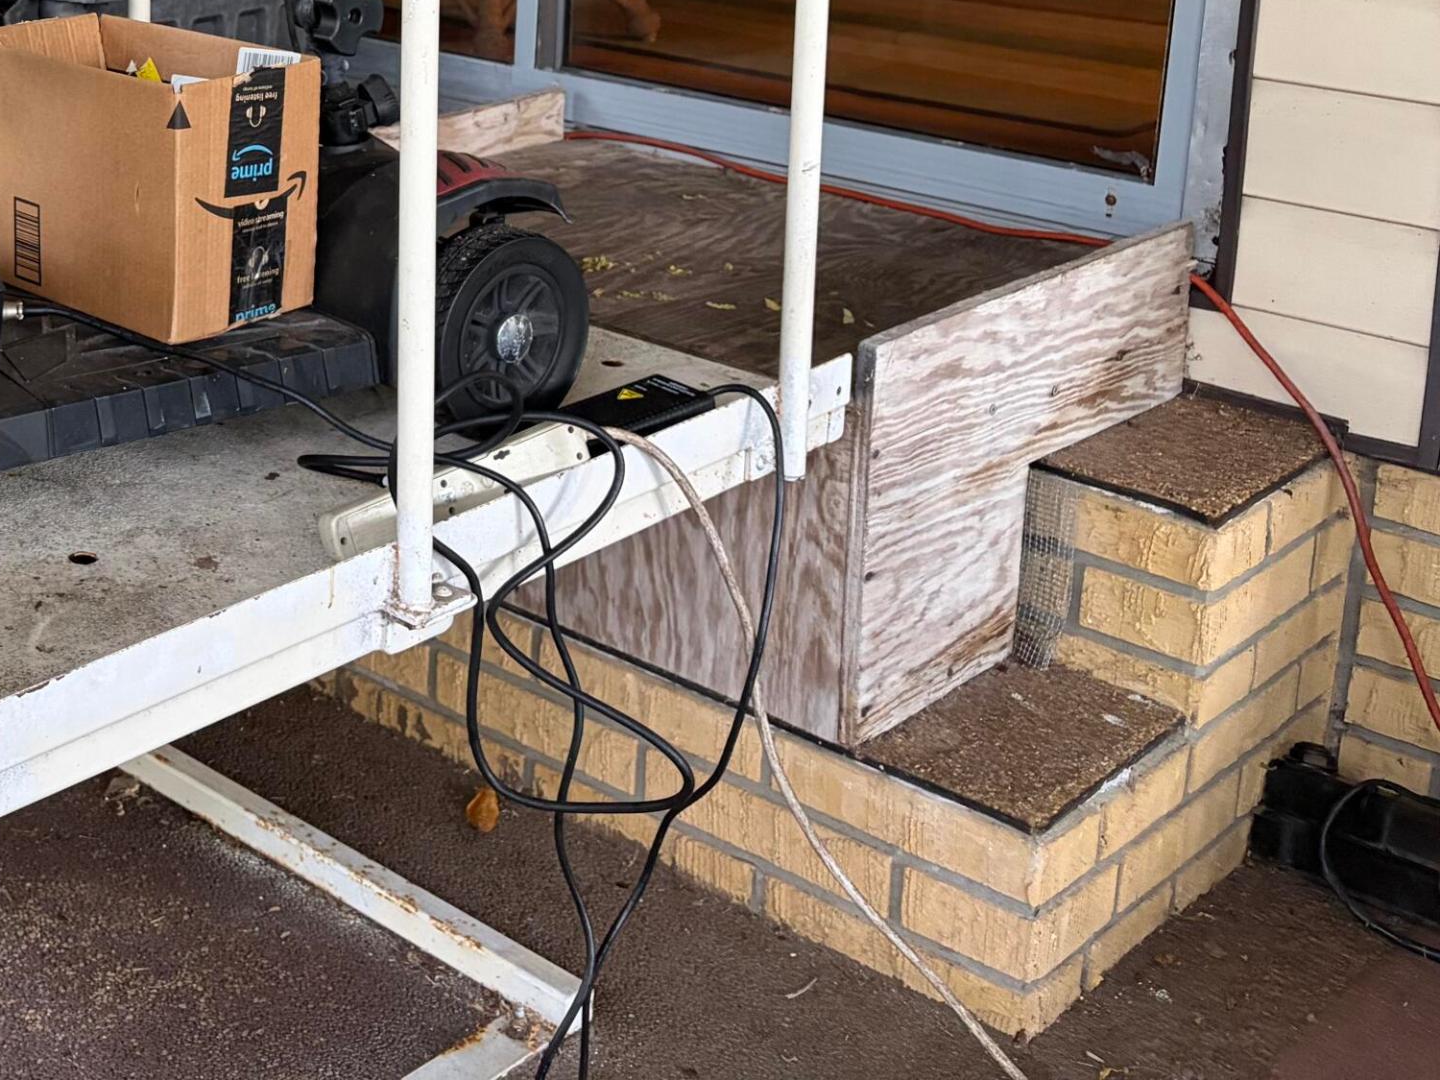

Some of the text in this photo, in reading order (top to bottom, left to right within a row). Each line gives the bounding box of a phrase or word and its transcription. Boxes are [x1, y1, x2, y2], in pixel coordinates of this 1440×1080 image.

[235, 91, 278, 103] free listening
[231, 157, 273, 182] prime
[237, 217, 255, 227] video
[255, 211, 285, 223] streaming
[236, 267, 280, 284] free lening
[235, 303, 277, 322] prime
